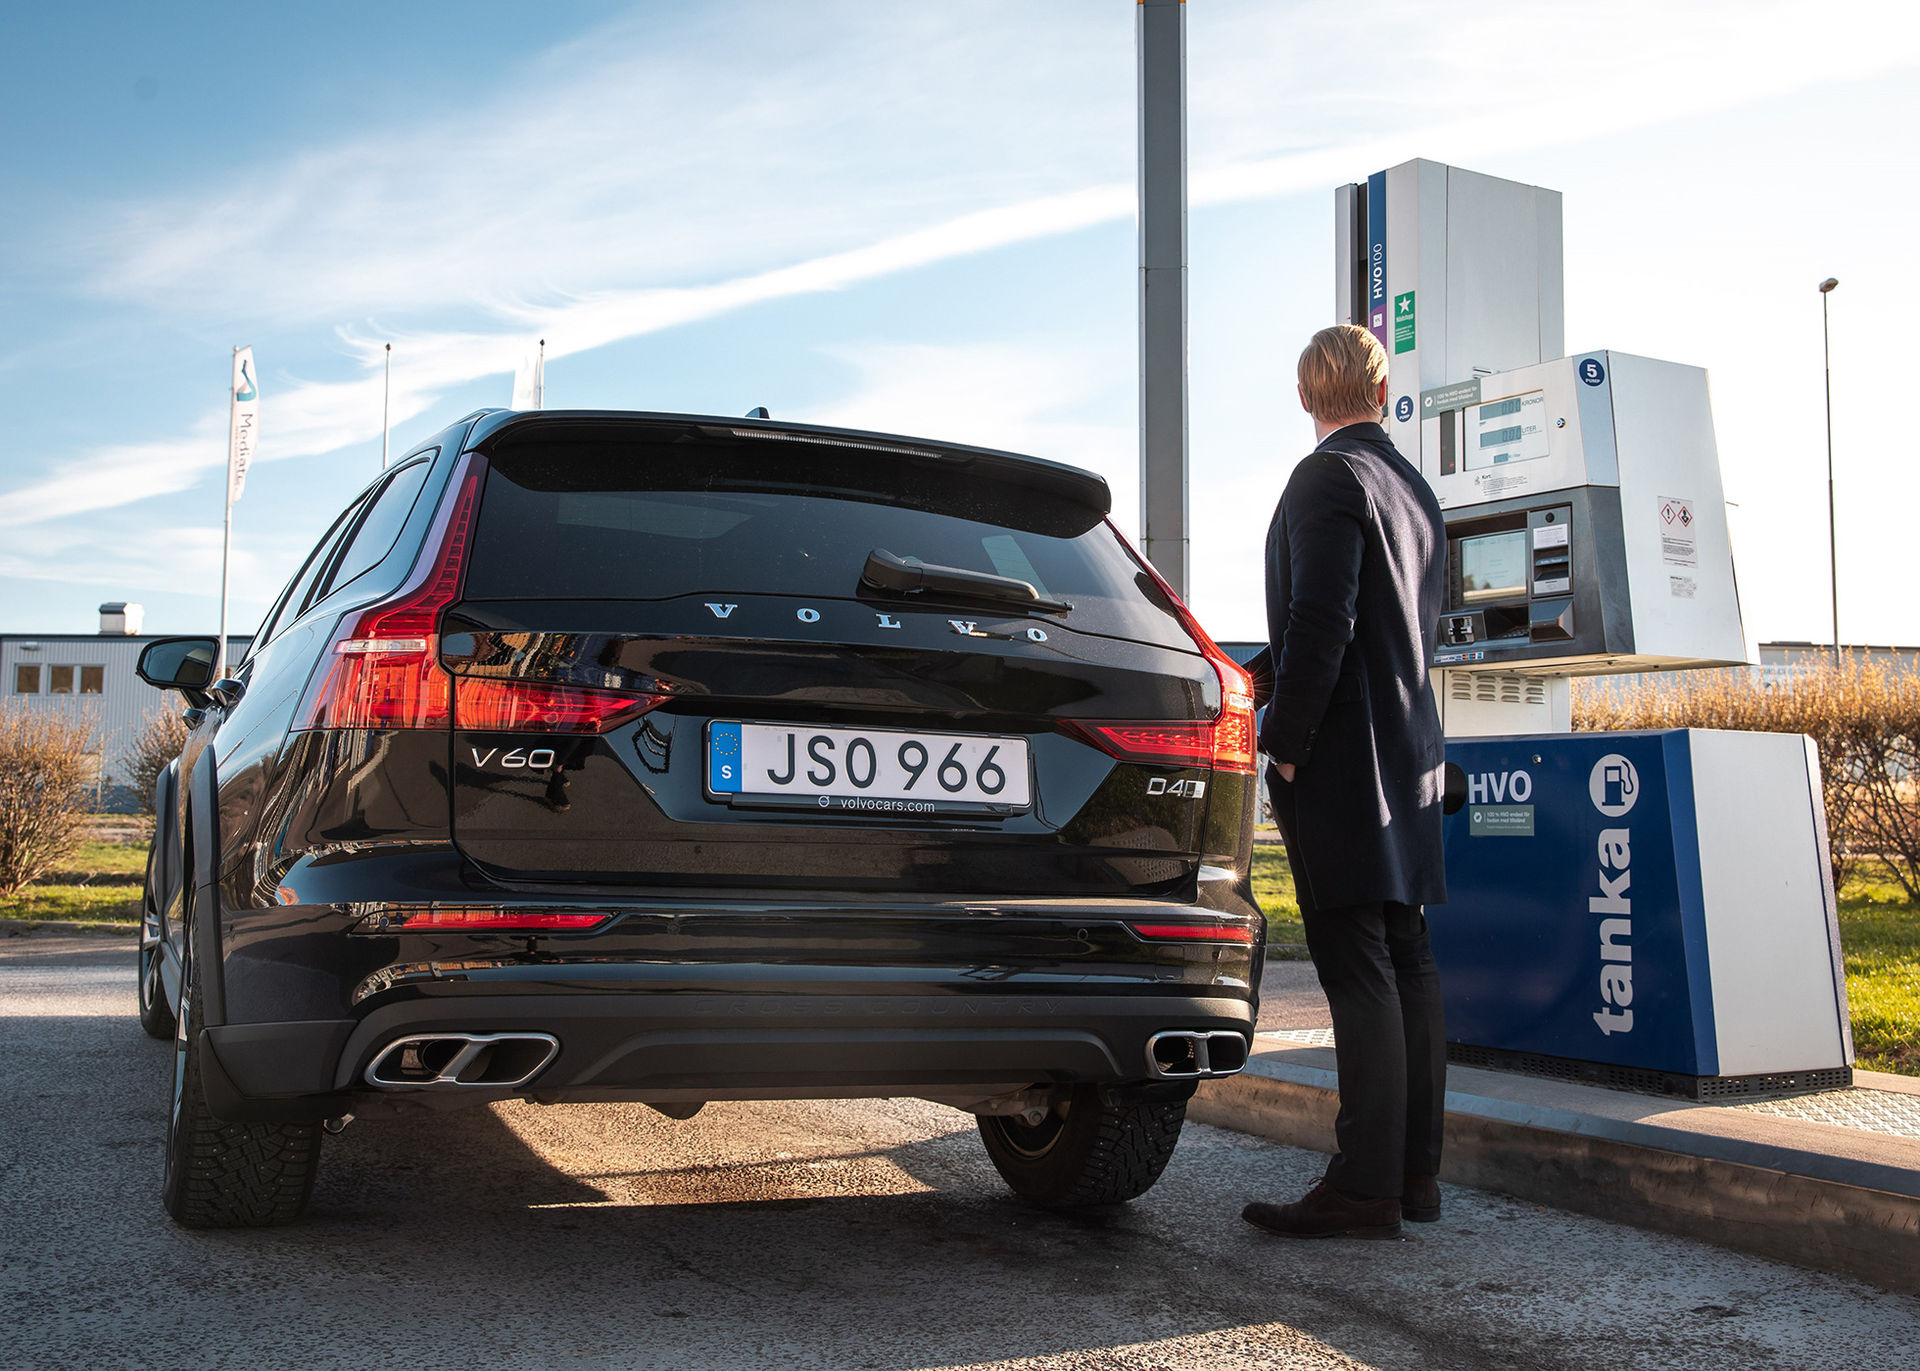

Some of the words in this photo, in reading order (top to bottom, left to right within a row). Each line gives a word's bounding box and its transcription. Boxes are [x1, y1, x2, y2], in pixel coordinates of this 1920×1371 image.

[1373, 243, 1383, 299] HVO100
[1586, 364, 1598, 378] 5
[1401, 401, 1409, 415] 5
[1522, 397, 1544, 406] KRONOR
[704, 602, 1049, 643] VOLVO
[721, 765, 733, 780] S
[897, 740, 1006, 796] 966
[1468, 770, 1533, 804] HVO
[840, 797, 936, 813] volvocars.com
[1589, 828, 1634, 1036] tanka
